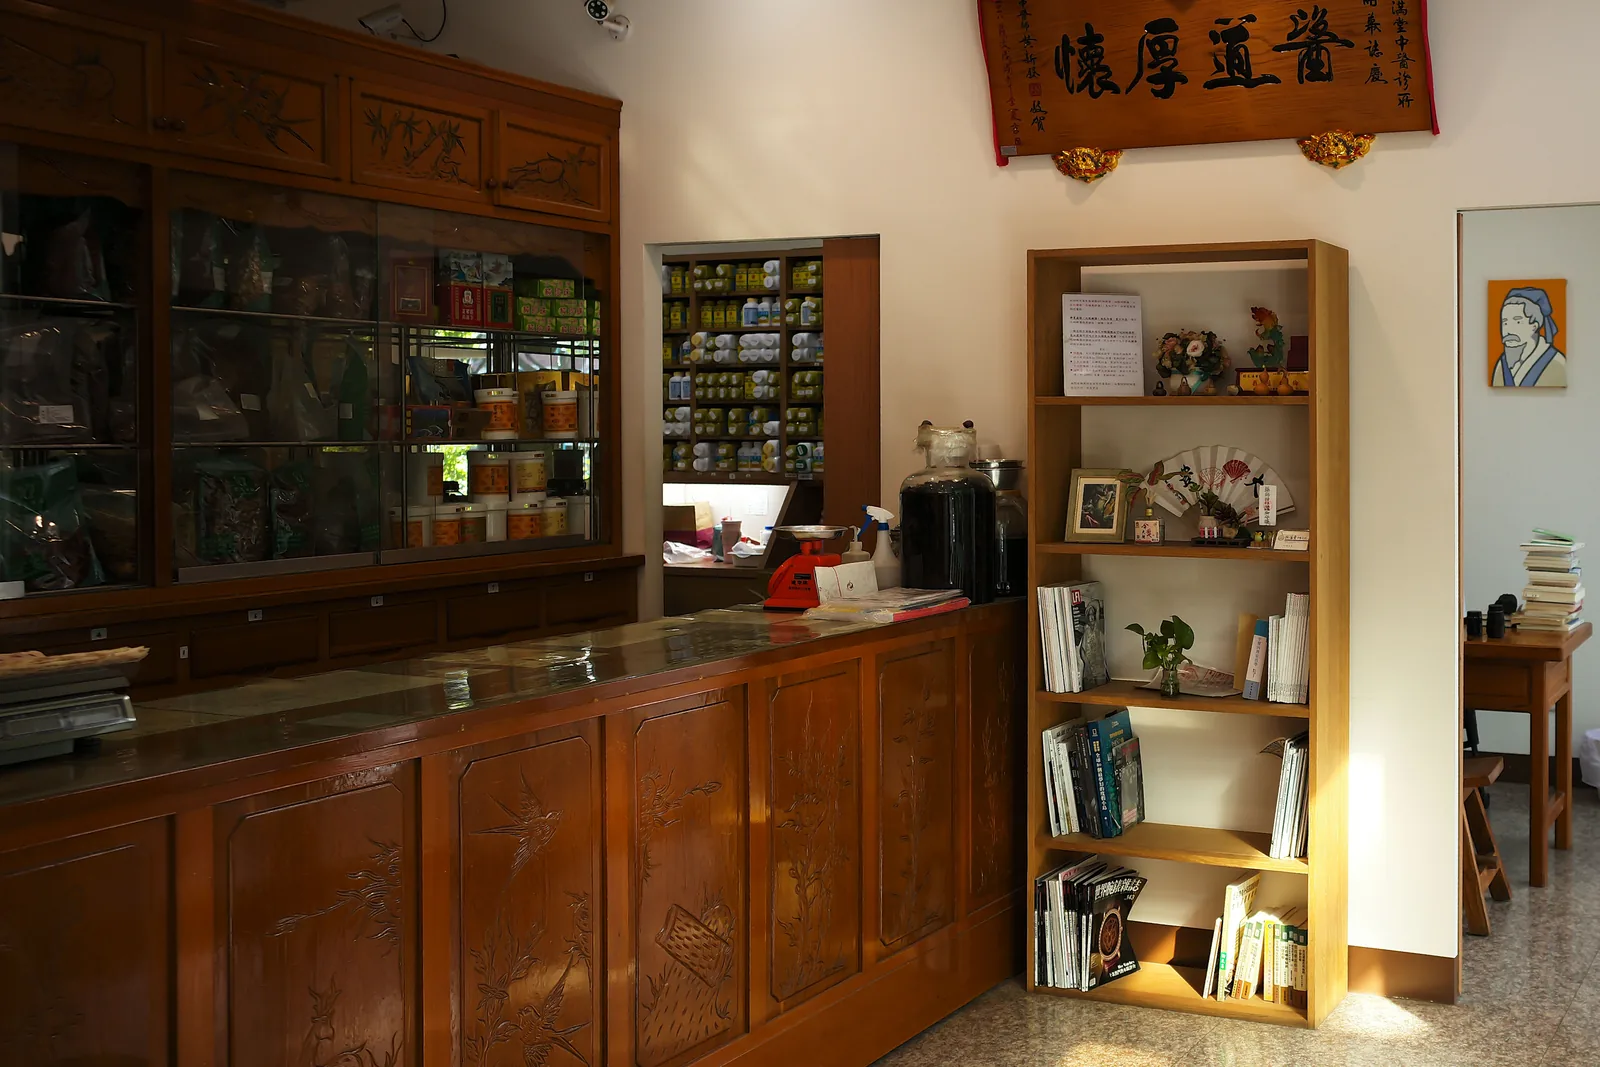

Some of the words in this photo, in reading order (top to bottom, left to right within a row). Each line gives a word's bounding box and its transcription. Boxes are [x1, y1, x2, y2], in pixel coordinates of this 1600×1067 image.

[1390, 0, 1416, 109] 滿堂中醫診所
